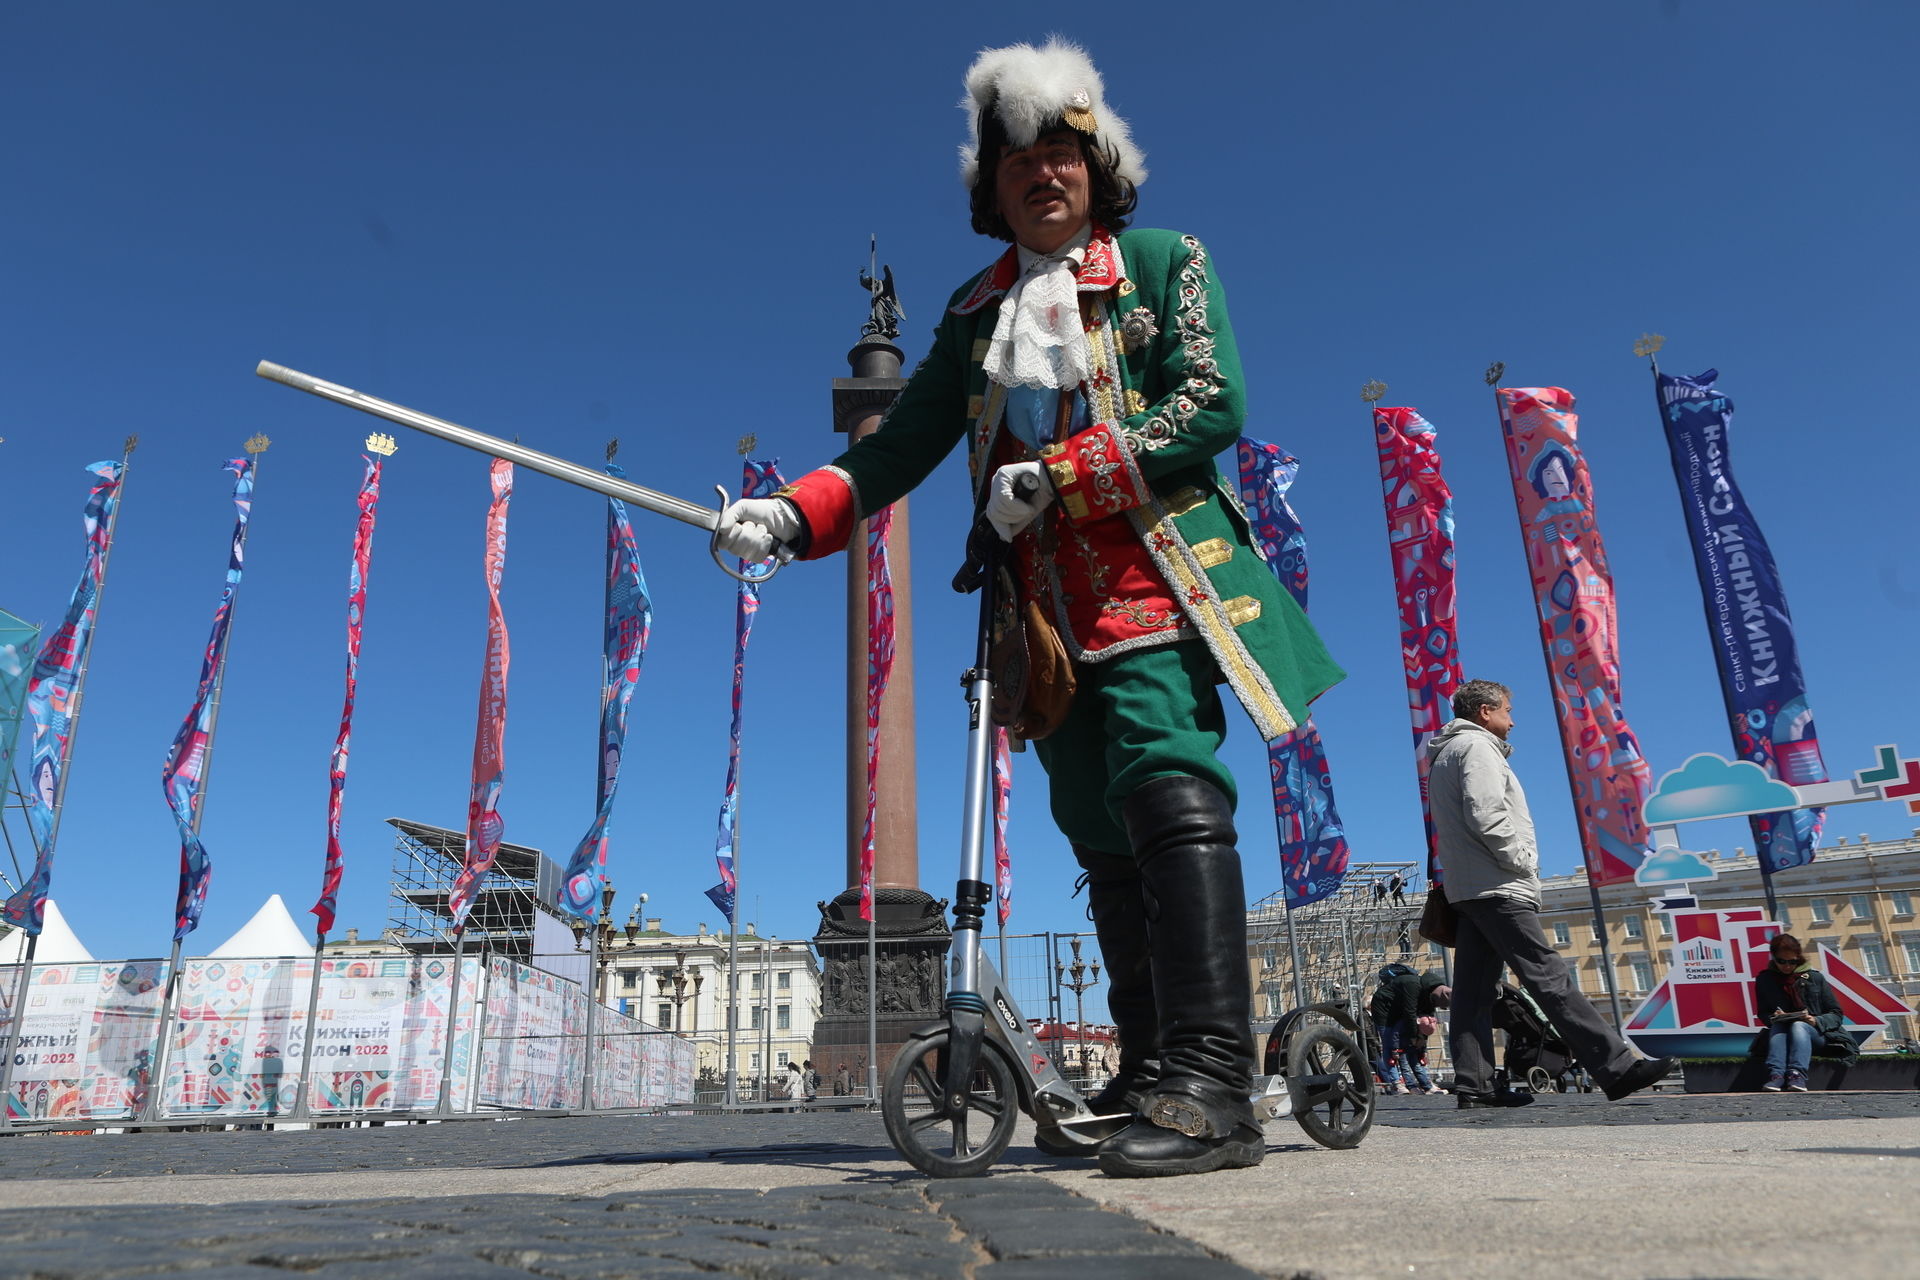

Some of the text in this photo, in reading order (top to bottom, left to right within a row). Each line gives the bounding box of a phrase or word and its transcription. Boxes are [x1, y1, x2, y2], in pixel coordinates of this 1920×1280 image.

[1703, 424, 1780, 687] Книжный Салон
[1703, 542, 1747, 693] Санкт-Петербургский
[1685, 965, 1726, 973] Книжный
[997, 998, 1017, 1029] oxelo
[288, 1021, 391, 1040] Кижный
[41, 1052, 76, 1065] 2022
[287, 1043, 389, 1058] Слон 2022
